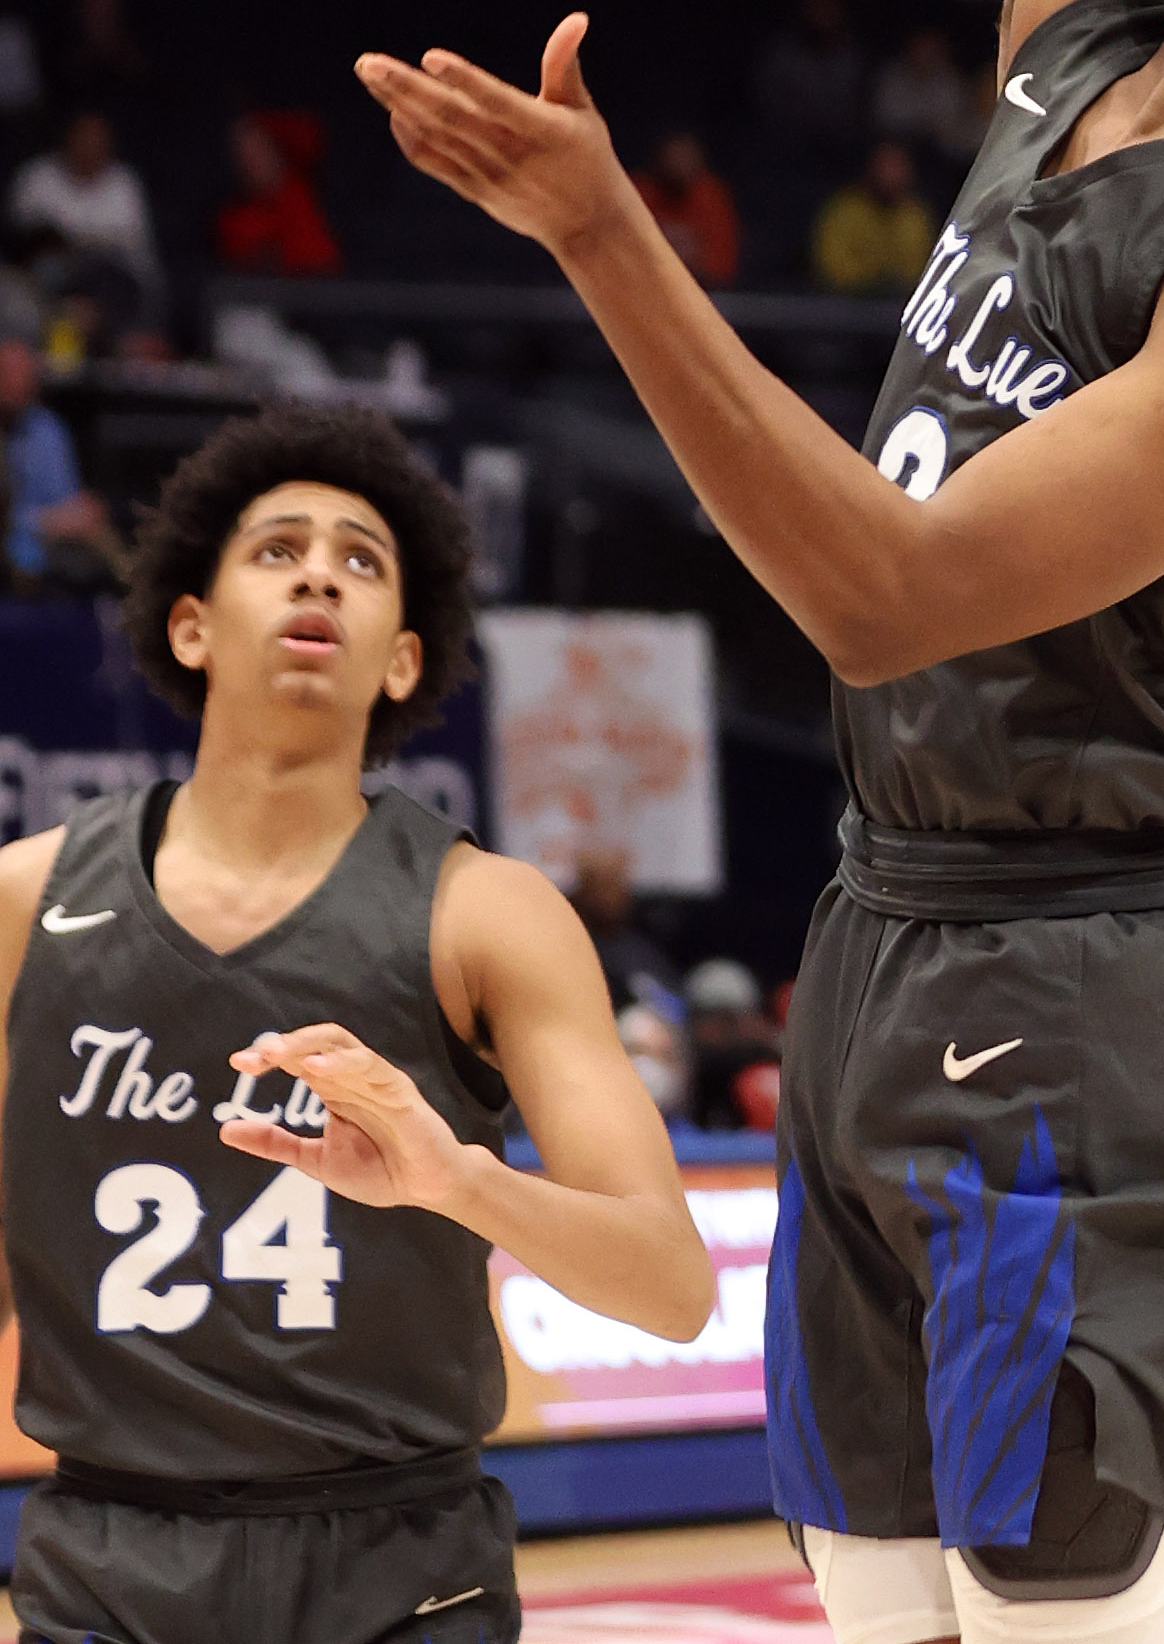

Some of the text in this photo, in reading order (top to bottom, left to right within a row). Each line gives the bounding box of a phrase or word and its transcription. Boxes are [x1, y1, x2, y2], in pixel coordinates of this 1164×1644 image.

[900, 220, 1069, 420] The Lue
[58, 1023, 330, 1129] The Lu
[94, 1161, 344, 1335] 24
